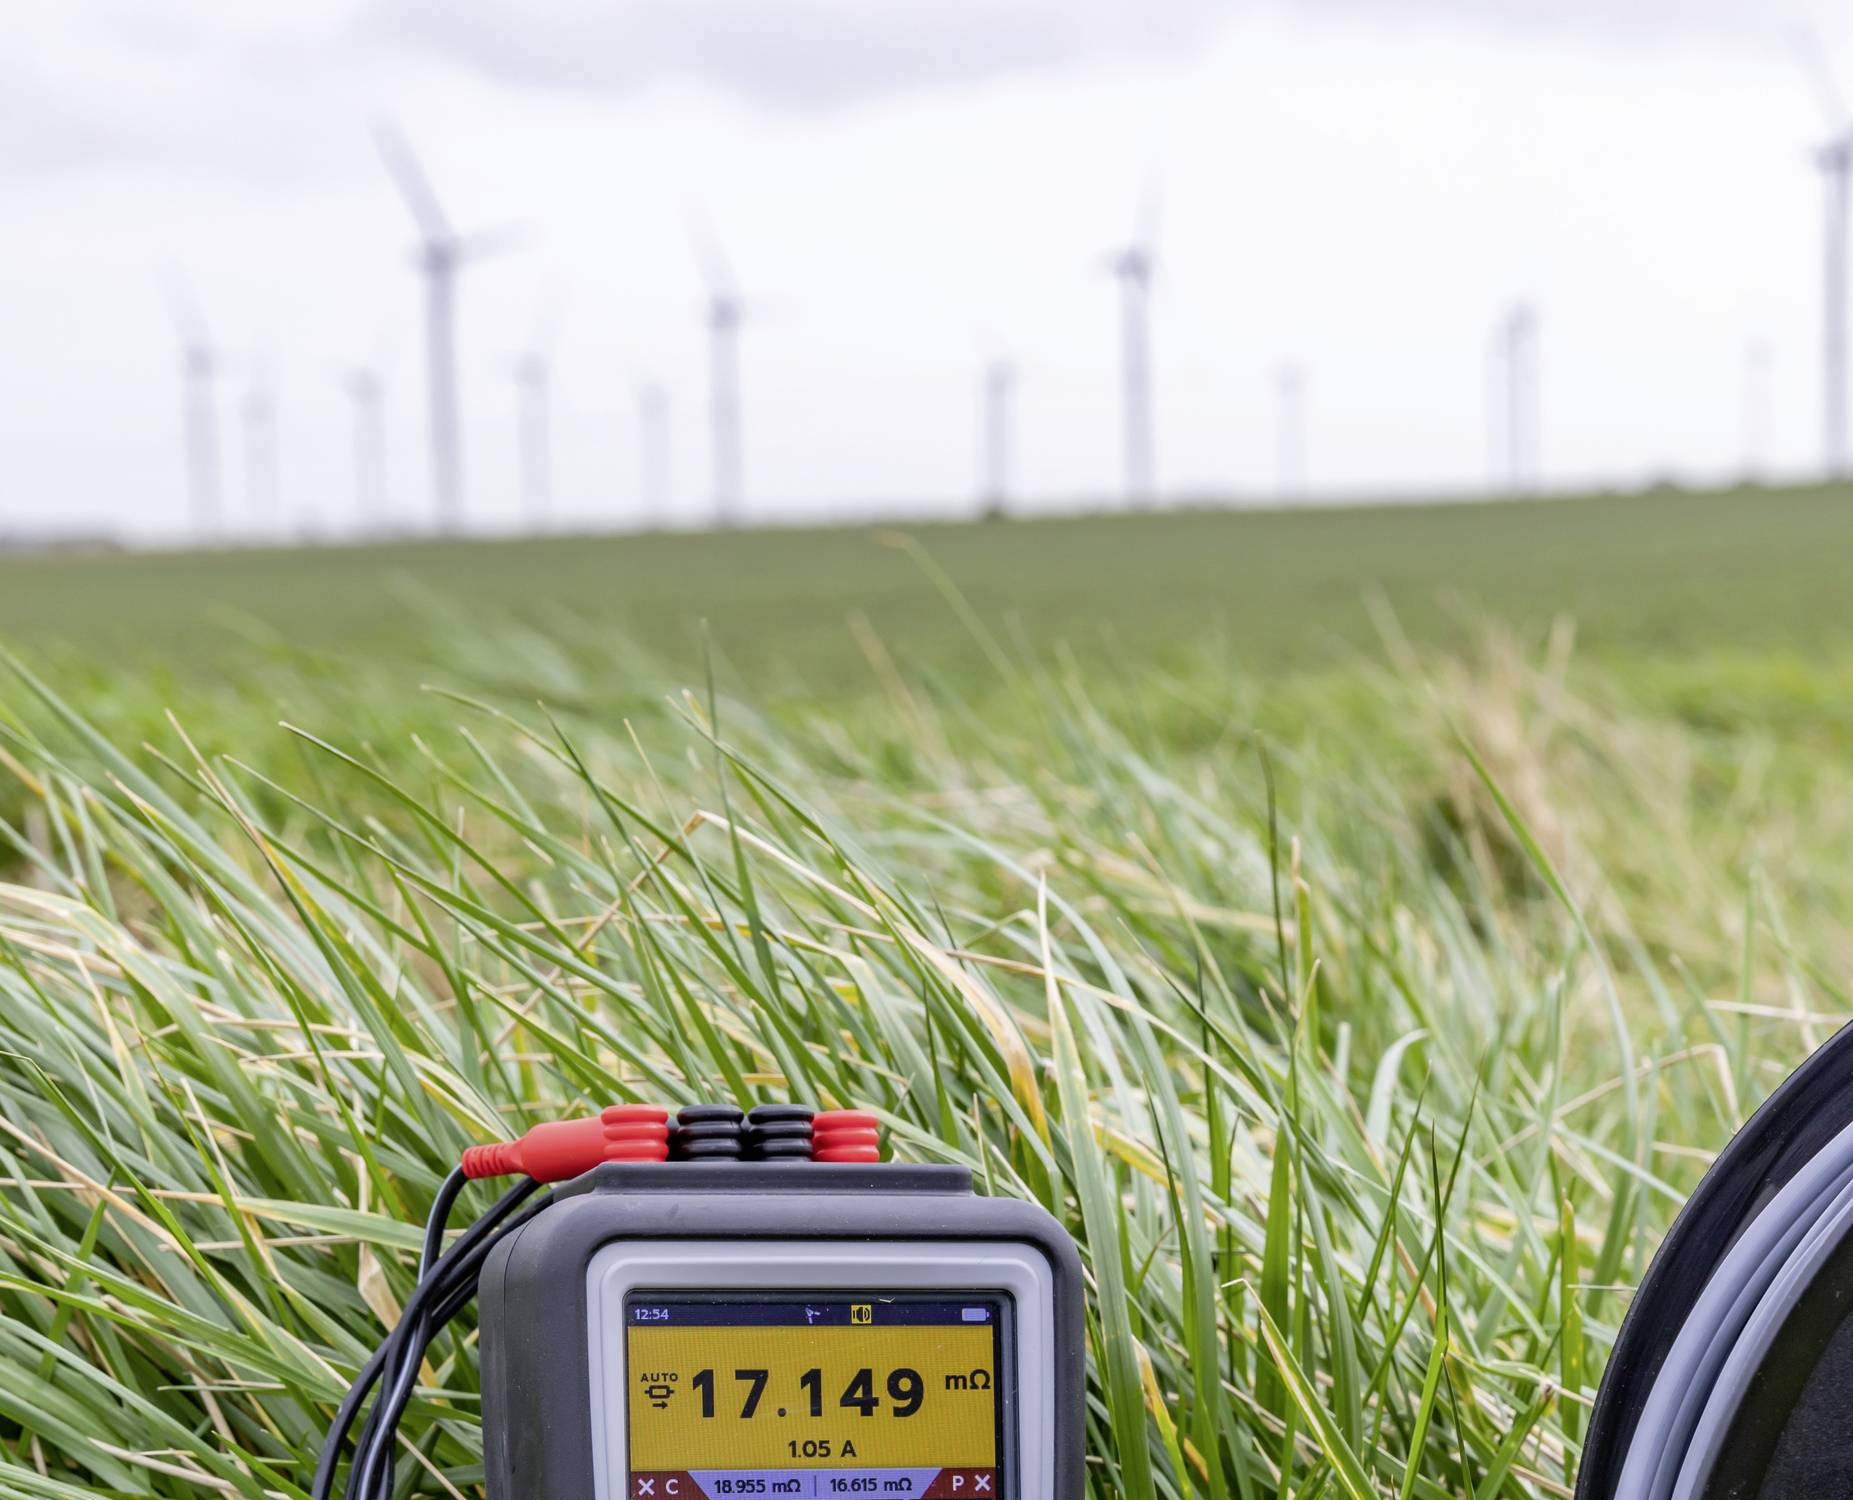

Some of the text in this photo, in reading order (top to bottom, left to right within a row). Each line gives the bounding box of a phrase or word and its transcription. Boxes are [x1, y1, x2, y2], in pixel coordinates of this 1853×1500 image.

[634, 1308, 669, 1321] 12:54
[640, 1373, 679, 1383] AUTO
[692, 1368, 991, 1419] 17.149 mΩ
[788, 1440, 857, 1458] 1.05 A
[665, 1478, 679, 1495] C
[714, 1479, 800, 1494] 18.955 mΩ
[830, 1477, 912, 1492] 16.615 mΩ
[952, 1475, 964, 1491] P
